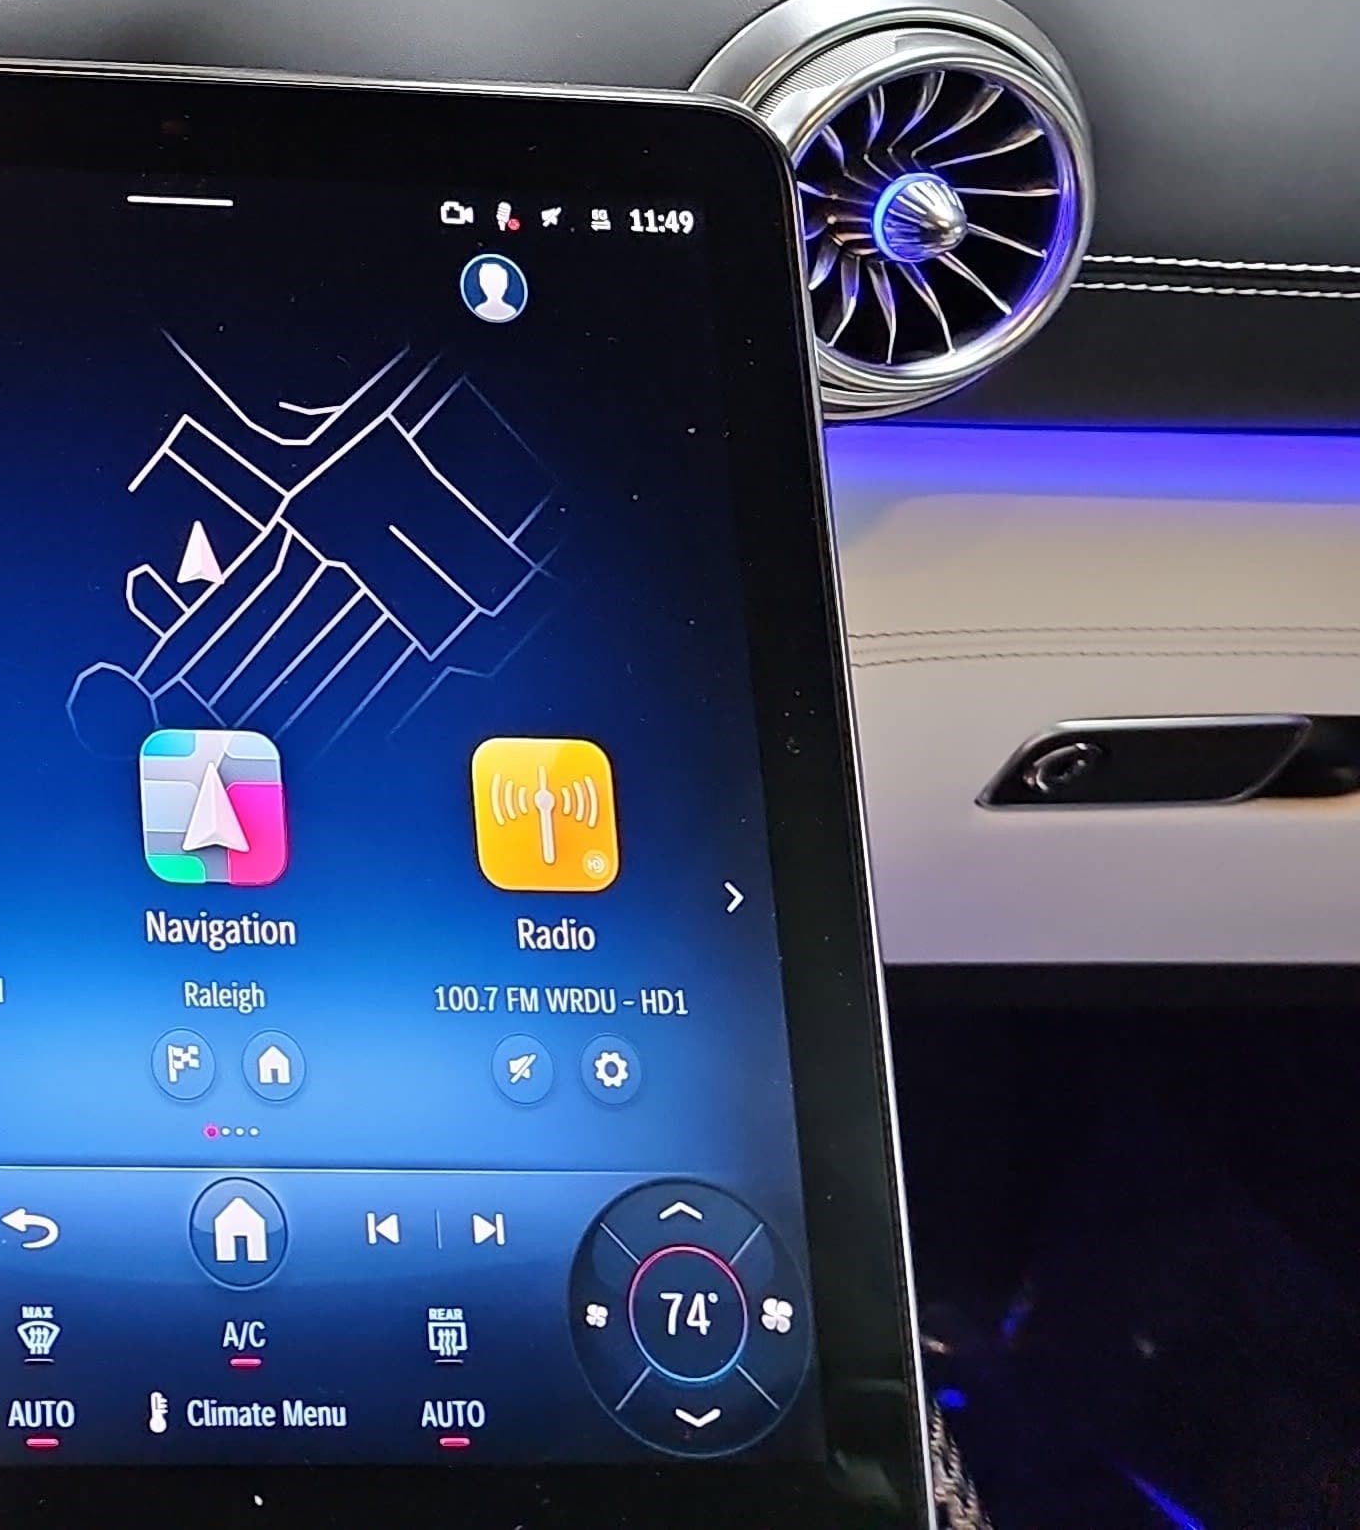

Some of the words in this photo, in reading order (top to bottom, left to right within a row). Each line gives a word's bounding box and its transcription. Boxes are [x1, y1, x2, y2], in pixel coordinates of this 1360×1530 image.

[630, 207, 695, 234] 11:49
[145, 911, 298, 952] Navigation
[517, 918, 596, 951] Radio
[183, 981, 265, 1015] Raleigh
[434, 985, 499, 1014] 100.7
[506, 987, 540, 1014] FM
[545, 988, 616, 1015] WRDU
[640, 989, 689, 1016] HD1
[22, 1306, 54, 1319] MAX
[429, 1308, 463, 1321] REAR
[659, 1291, 720, 1336] 74°
[222, 1320, 266, 1350] A/C
[7, 1400, 76, 1429] AUTO
[186, 1400, 277, 1429] Climate
[283, 1401, 347, 1429] Menu
[421, 1400, 486, 1429] AUTO
